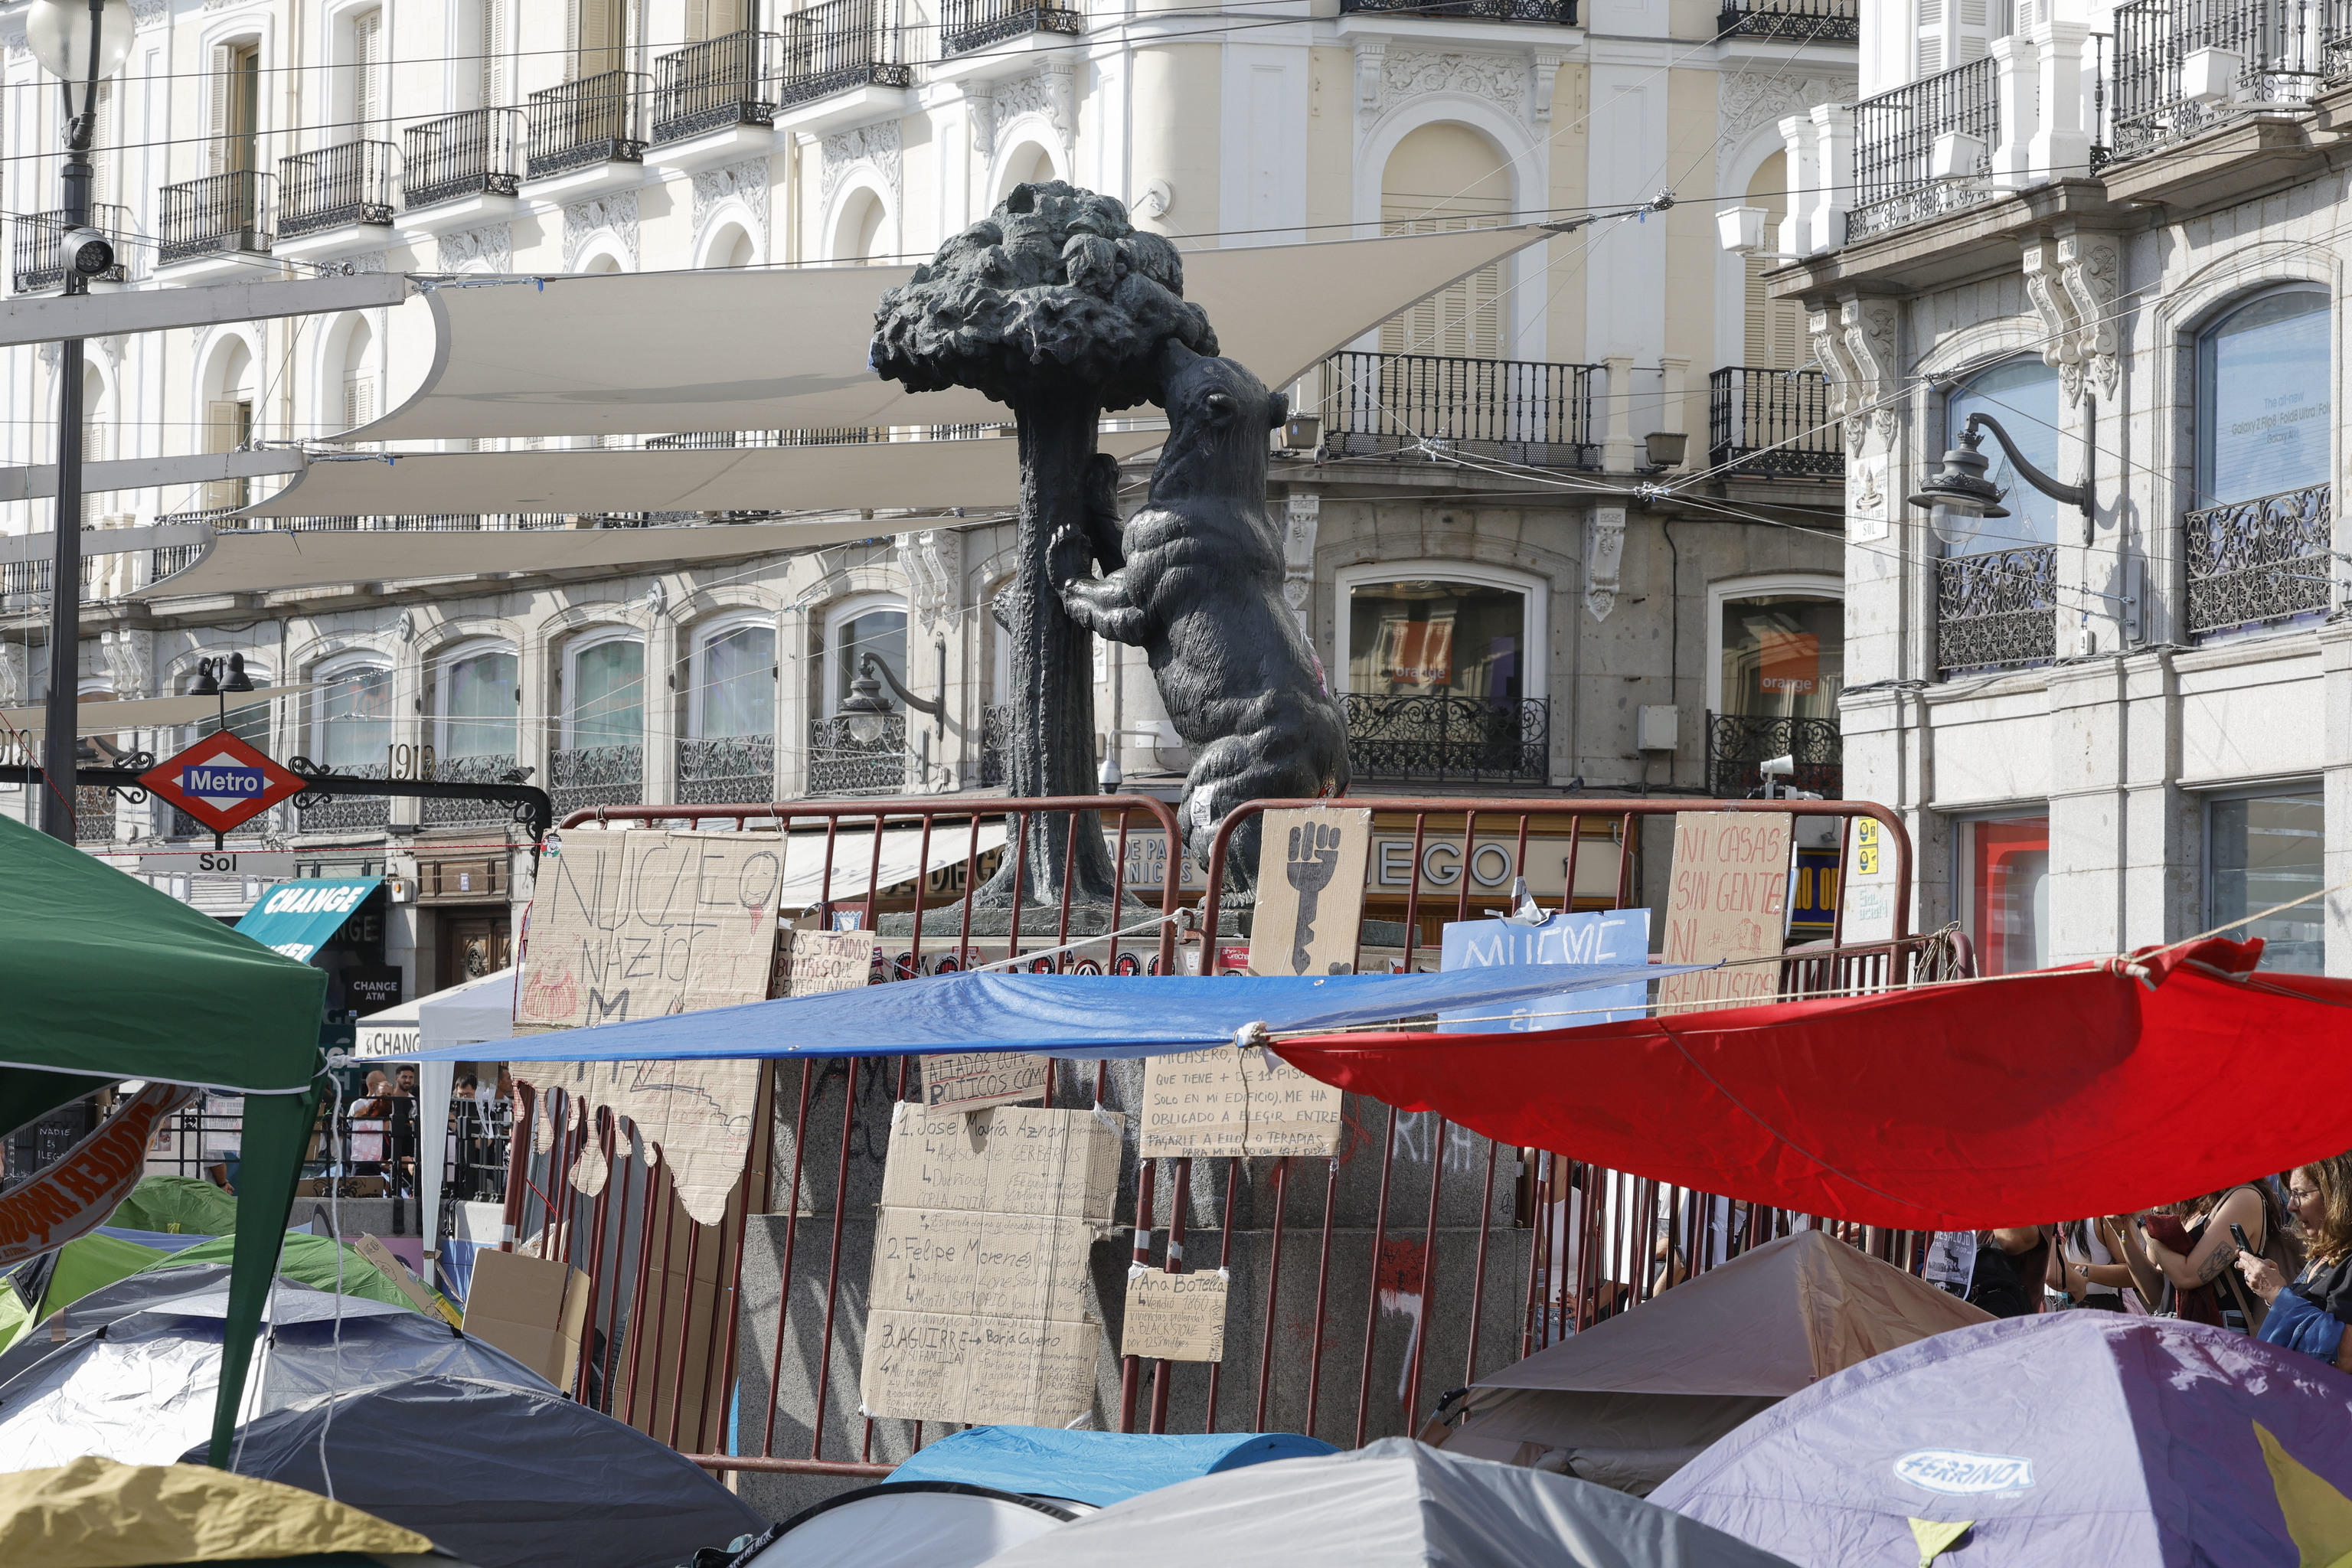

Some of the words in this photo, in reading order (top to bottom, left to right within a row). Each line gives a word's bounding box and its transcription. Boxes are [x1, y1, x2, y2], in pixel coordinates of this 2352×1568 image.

[2264, 397, 2277, 410] The
[2278, 391, 2305, 407] all-new
[2232, 422, 2255, 436] Galaxy
[2262, 413, 2277, 432] Flip8
[2279, 408, 2298, 424] Fold8
[2299, 407, 2315, 421] Ultra
[2267, 432, 2288, 444] Galaxy
[1863, 522, 1877, 536] SOL
[1395, 667, 1446, 681] orange
[1762, 676, 1812, 692] orange
[387, 743, 436, 780] 1919
[190, 769, 259, 793] Metro
[1681, 827, 1707, 863] NI
[1718, 826, 1781, 864] CASAS
[199, 853, 237, 871] Sol
[264, 886, 366, 914] CHANGE
[1677, 871, 1710, 910] SIN
[1717, 872, 1785, 915] GENTE
[779, 931, 806, 956] LOS
[828, 936, 871, 962] FONDOS
[1671, 918, 1697, 962] NI
[354, 981, 397, 991] CHANGE
[365, 992, 385, 1001] ATM
[1509, 1007, 1544, 1032] EL
[374, 1033, 420, 1055] CHANG
[929, 1052, 991, 1083] ALIADOS
[1156, 1073, 1177, 1085] QUE
[1220, 1073, 1230, 1083] +
[1236, 1072, 1254, 1083] DE
[1154, 1093, 1179, 1106] SOLO
[1184, 1093, 1200, 1104] EN
[1285, 1089, 1302, 1103] ME
[1310, 1089, 1328, 1100] HA
[899, 1116, 913, 1137] 1.
[916, 1112, 957, 1136] Jose
[963, 1111, 1008, 1138] María
[1017, 1114, 1065, 1139] Aznar
[1221, 1112, 1230, 1122] A
[1296, 1110, 1339, 1123] ENTRE
[39, 1128, 71, 1137] NADIE
[1203, 1134, 1212, 1145] A
[1267, 1130, 1325, 1149] TERAPIAS
[47, 1140, 56, 1148] ES
[936, 1145, 979, 1163] Asesor
[987, 1148, 1004, 1162] de
[1010, 1142, 1082, 1163] CERBERUS
[1182, 1147, 1207, 1157] PARA
[887, 1237, 900, 1260] 2.
[904, 1236, 956, 1263] Felipe
[962, 1238, 1033, 1269] Morenés
[978, 1271, 1011, 1290] Lone
[1138, 1272, 1170, 1292] Ana
[1173, 1274, 1225, 1293] Botella
[1146, 1292, 1175, 1310] Vendió
[1183, 1294, 1209, 1312] 1860
[1129, 1311, 1167, 1322] viviendas
[1169, 1309, 1205, 1327] protegidas
[897, 1326, 969, 1351] AGUIRRE
[985, 1328, 1018, 1347] Borja
[1129, 1325, 1135, 1335] a
[1126, 1338, 1142, 1351] por
[1903, 1455, 2022, 1484] FERRINO
